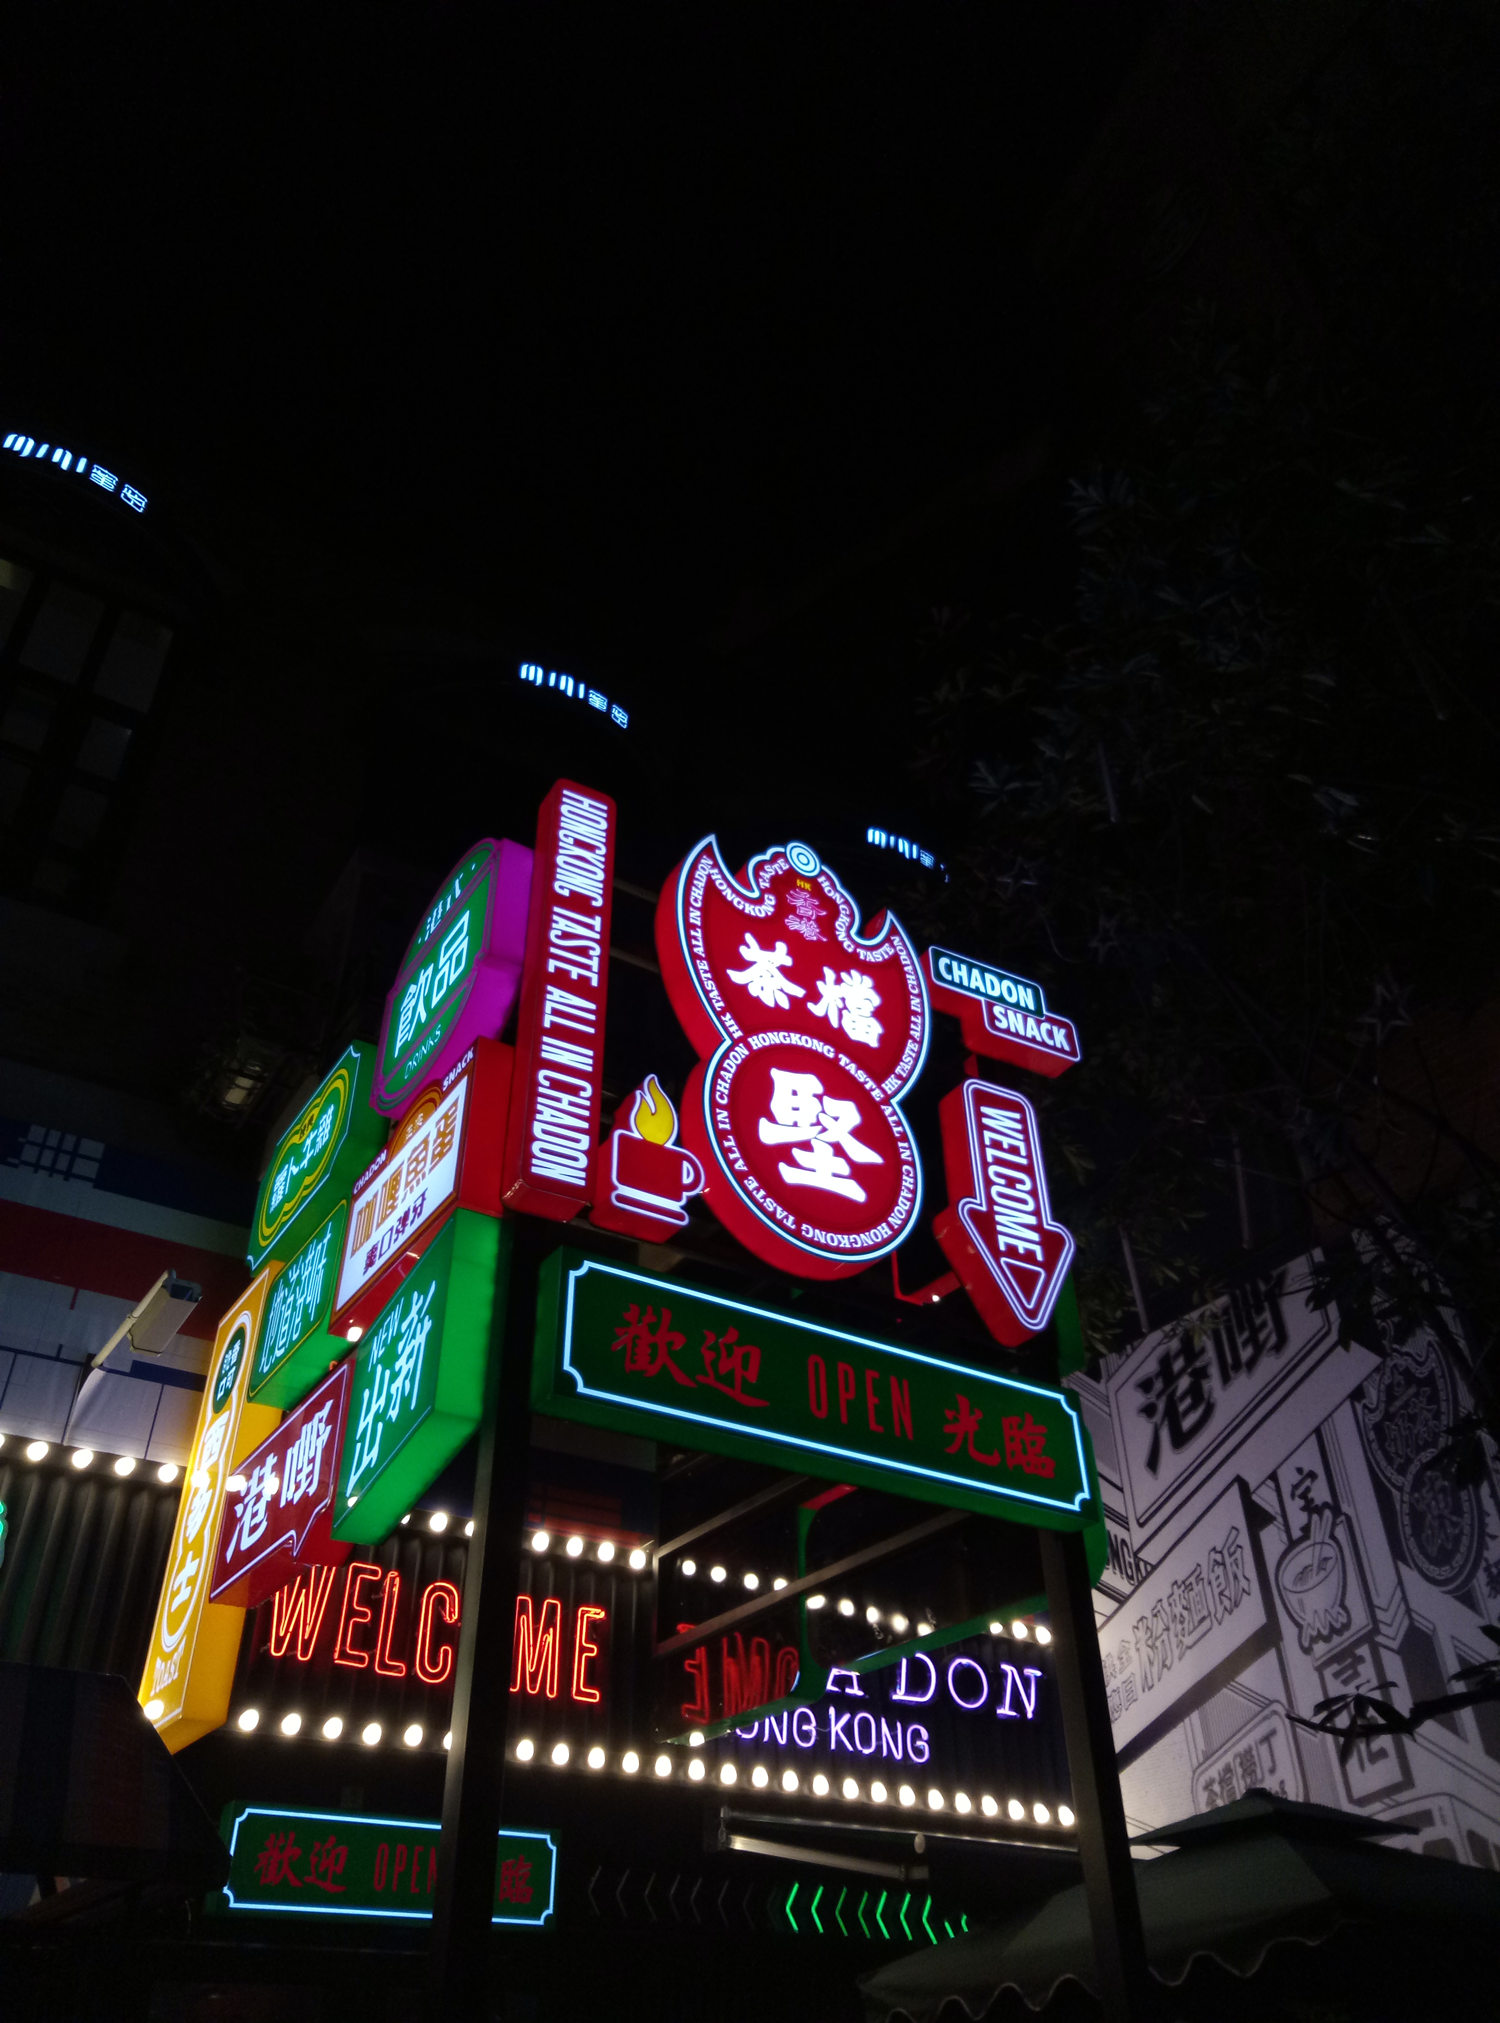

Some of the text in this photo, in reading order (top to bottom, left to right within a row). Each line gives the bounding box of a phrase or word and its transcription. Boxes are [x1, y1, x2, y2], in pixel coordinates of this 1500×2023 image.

[3, 433, 88, 474] mini
[520, 663, 585, 699] mini
[867, 828, 918, 859] mini
[709, 858, 790, 918] HONGKONG TASTE
[796, 878, 812, 892] HK
[689, 855, 744, 1039] HK TASTE ALL IN CHADON
[817, 875, 895, 963] HONGKONG TASTE
[394, 909, 471, 1059] 飲品
[530, 788, 609, 1187] HONGKONG TASTE ALL IN CHADON
[881, 934, 922, 1095] HK TASTE ALL IN CHADON
[937, 956, 1035, 1012] CHADON
[404, 1023, 442, 1080] DRINKS
[993, 1006, 1071, 1053] SNACK
[442, 1046, 474, 1092] SNACK
[353, 1148, 387, 1195] CHADON
[715, 1030, 915, 1249] HONGKONG TASTE ALL IN CHADON HONGKONG TASTE ALL IN CHADON
[979, 1105, 1043, 1262] WELCOME
[368, 1298, 404, 1372] NEW
[610, 1302, 1056, 1479] 歡迎 OPEN 光臨
[269, 1562, 606, 1703] WELCME
[149, 1634, 187, 1698] TOAST
[828, 1705, 931, 1764] KONG
[253, 1830, 349, 1895] 歡迎
[497, 1853, 534, 1905] 臨
